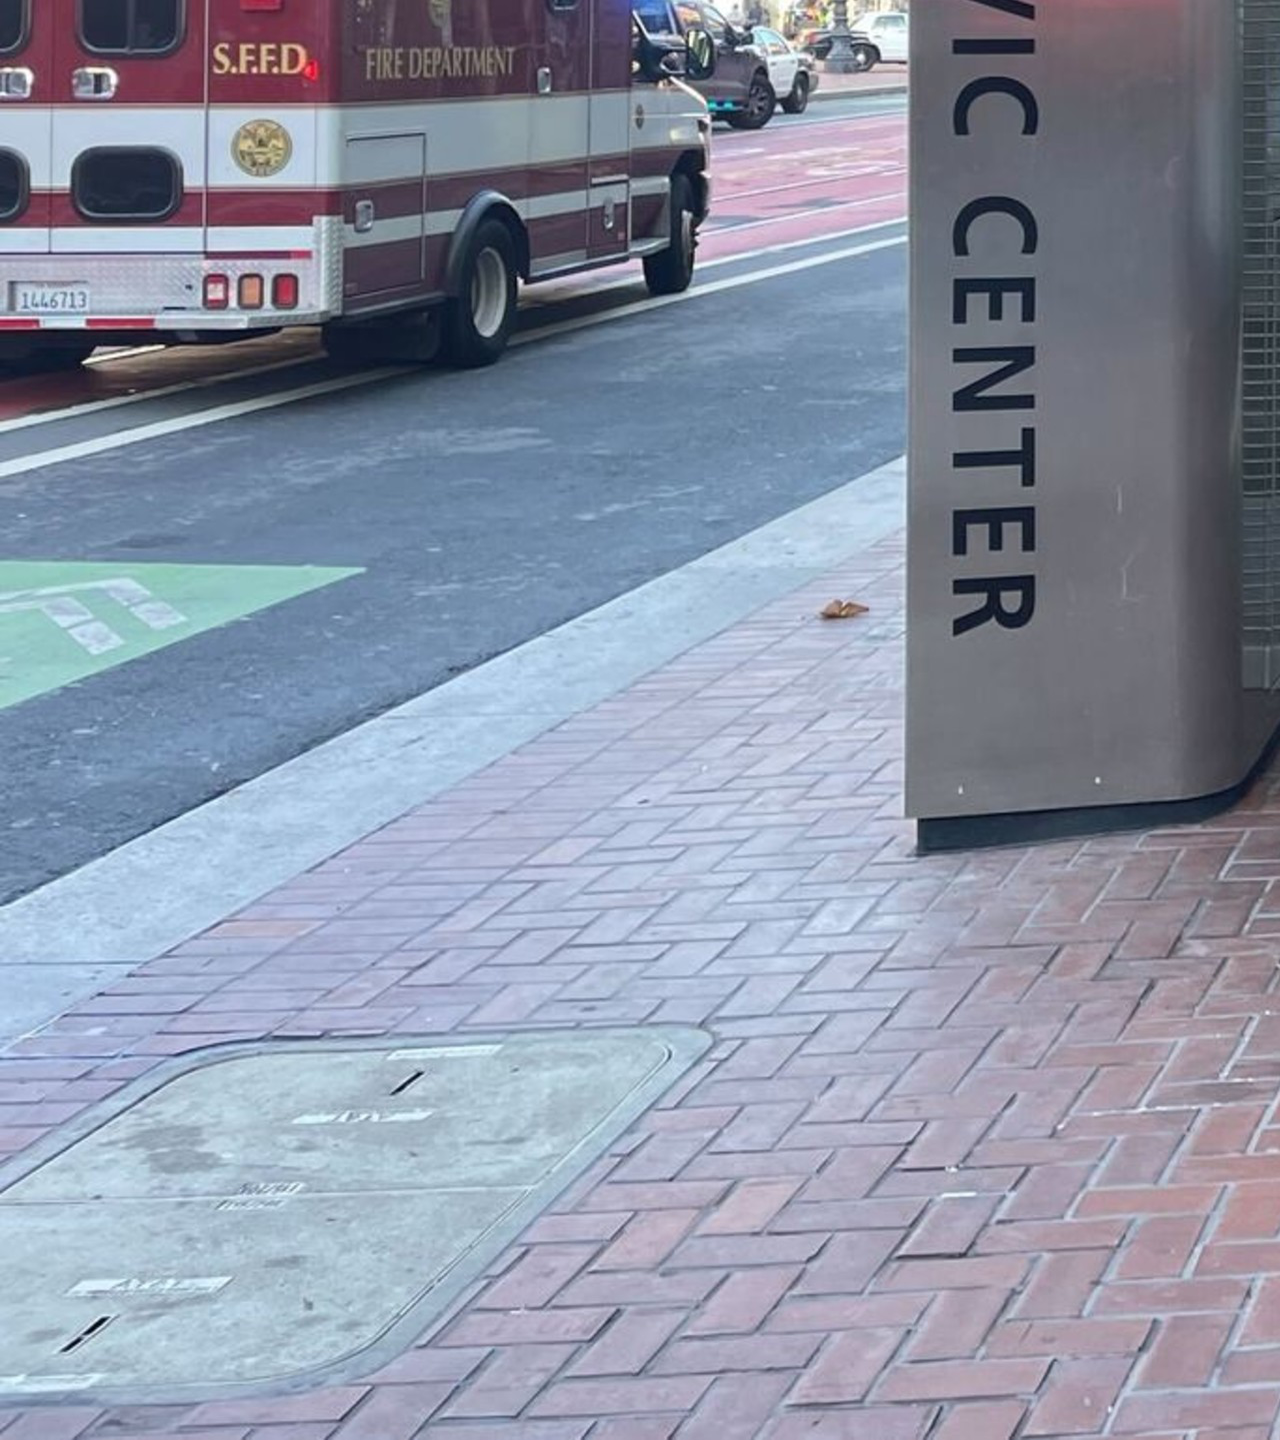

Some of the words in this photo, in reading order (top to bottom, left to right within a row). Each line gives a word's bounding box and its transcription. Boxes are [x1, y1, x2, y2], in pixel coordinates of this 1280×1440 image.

[366, 48, 404, 80] FIRE
[408, 46, 517, 79] DEPARTMENT
[21, 291, 88, 310] 1446713
[952, 195, 1039, 638] CENTER
